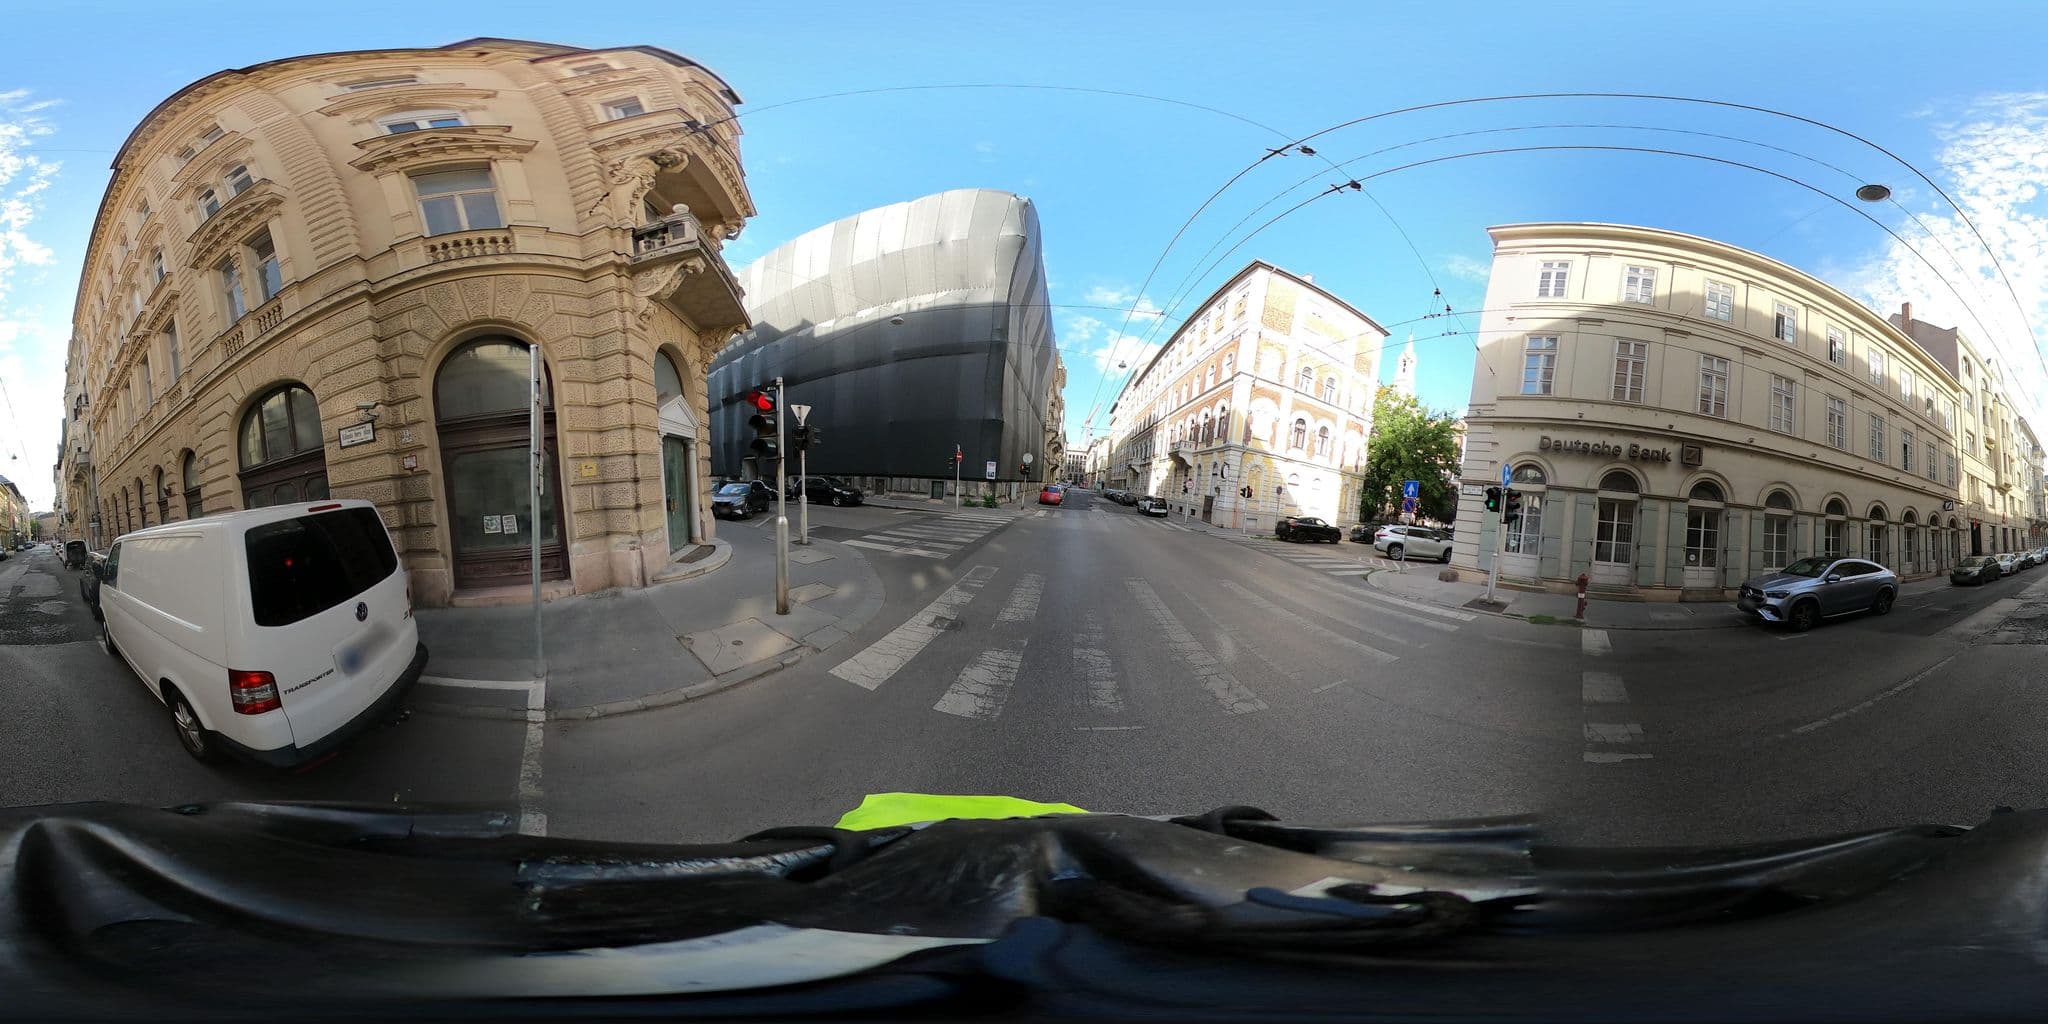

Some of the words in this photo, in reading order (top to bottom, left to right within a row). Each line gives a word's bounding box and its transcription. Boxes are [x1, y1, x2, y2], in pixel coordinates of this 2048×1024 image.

[1539, 436, 1622, 456] Deutsche
[1629, 443, 1672, 462] Bank
[283, 668, 334, 695] TRANSPORTER
